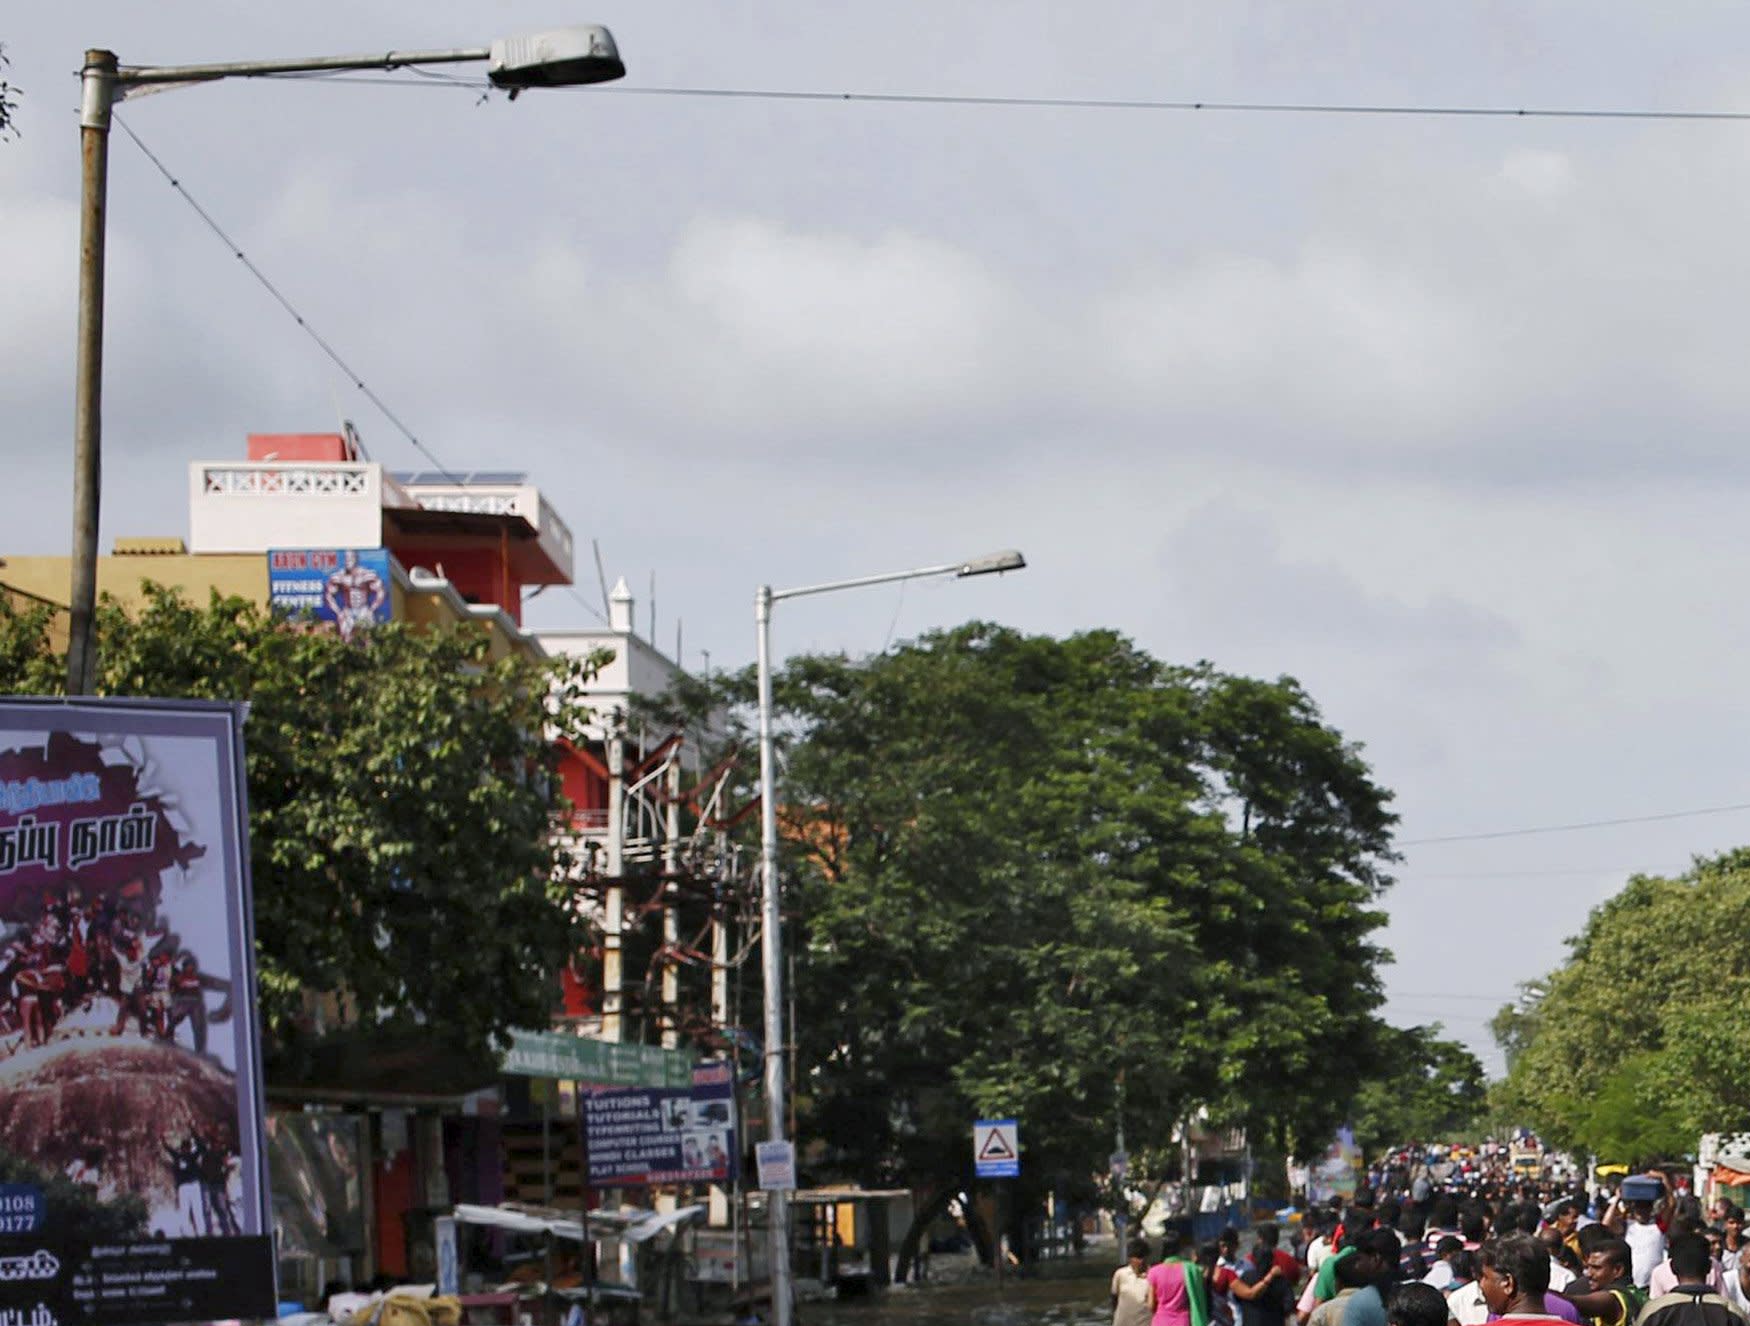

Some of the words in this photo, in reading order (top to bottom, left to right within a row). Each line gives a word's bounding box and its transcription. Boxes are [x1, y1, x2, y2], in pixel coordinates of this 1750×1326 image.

[272, 580, 323, 594] FITNESS
[68, 803, 157, 871] நாள்
[585, 1095, 651, 1111] TUITIONS
